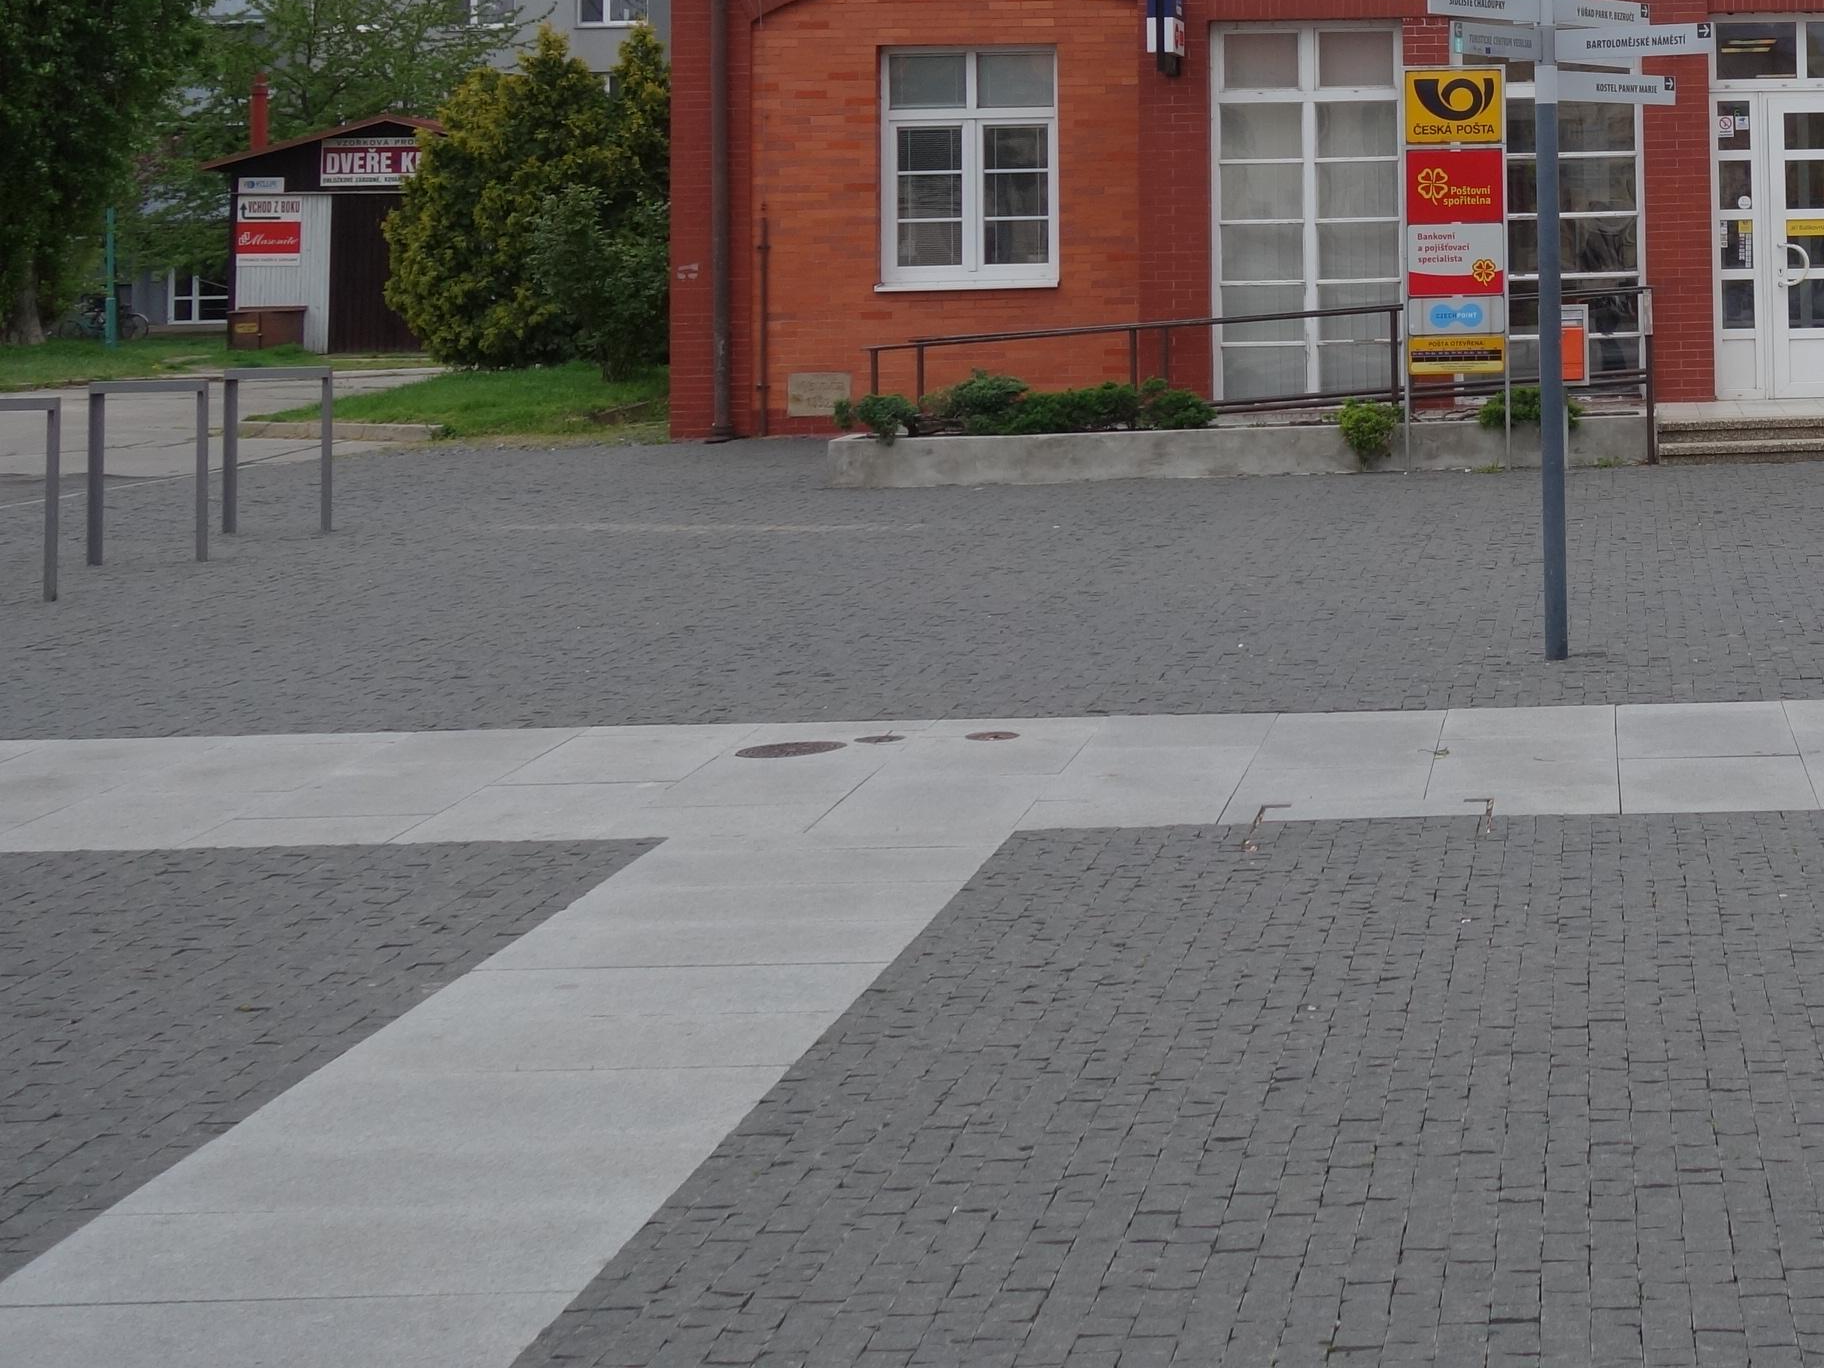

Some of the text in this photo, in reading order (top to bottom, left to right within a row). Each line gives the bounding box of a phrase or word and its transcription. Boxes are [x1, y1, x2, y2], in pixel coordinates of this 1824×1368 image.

[1586, 34, 1686, 49] BARTOLOMĚJSKÉ NÁMĚSTÍ
[1596, 83, 1658, 94] KOSTEL PANNY MARIE
[1413, 122, 1494, 135] ČESKÁ POŠTA
[326, 148, 392, 173] DVEŘE
[1451, 185, 1491, 195] Poštovní
[248, 200, 299, 213] VCHOD Z BOKU
[1443, 195, 1491, 207] spořitelna
[1417, 232, 1455, 240] Bankovní
[1424, 243, 1469, 253] pojišťovací
[1418, 255, 1462, 264] specialista
